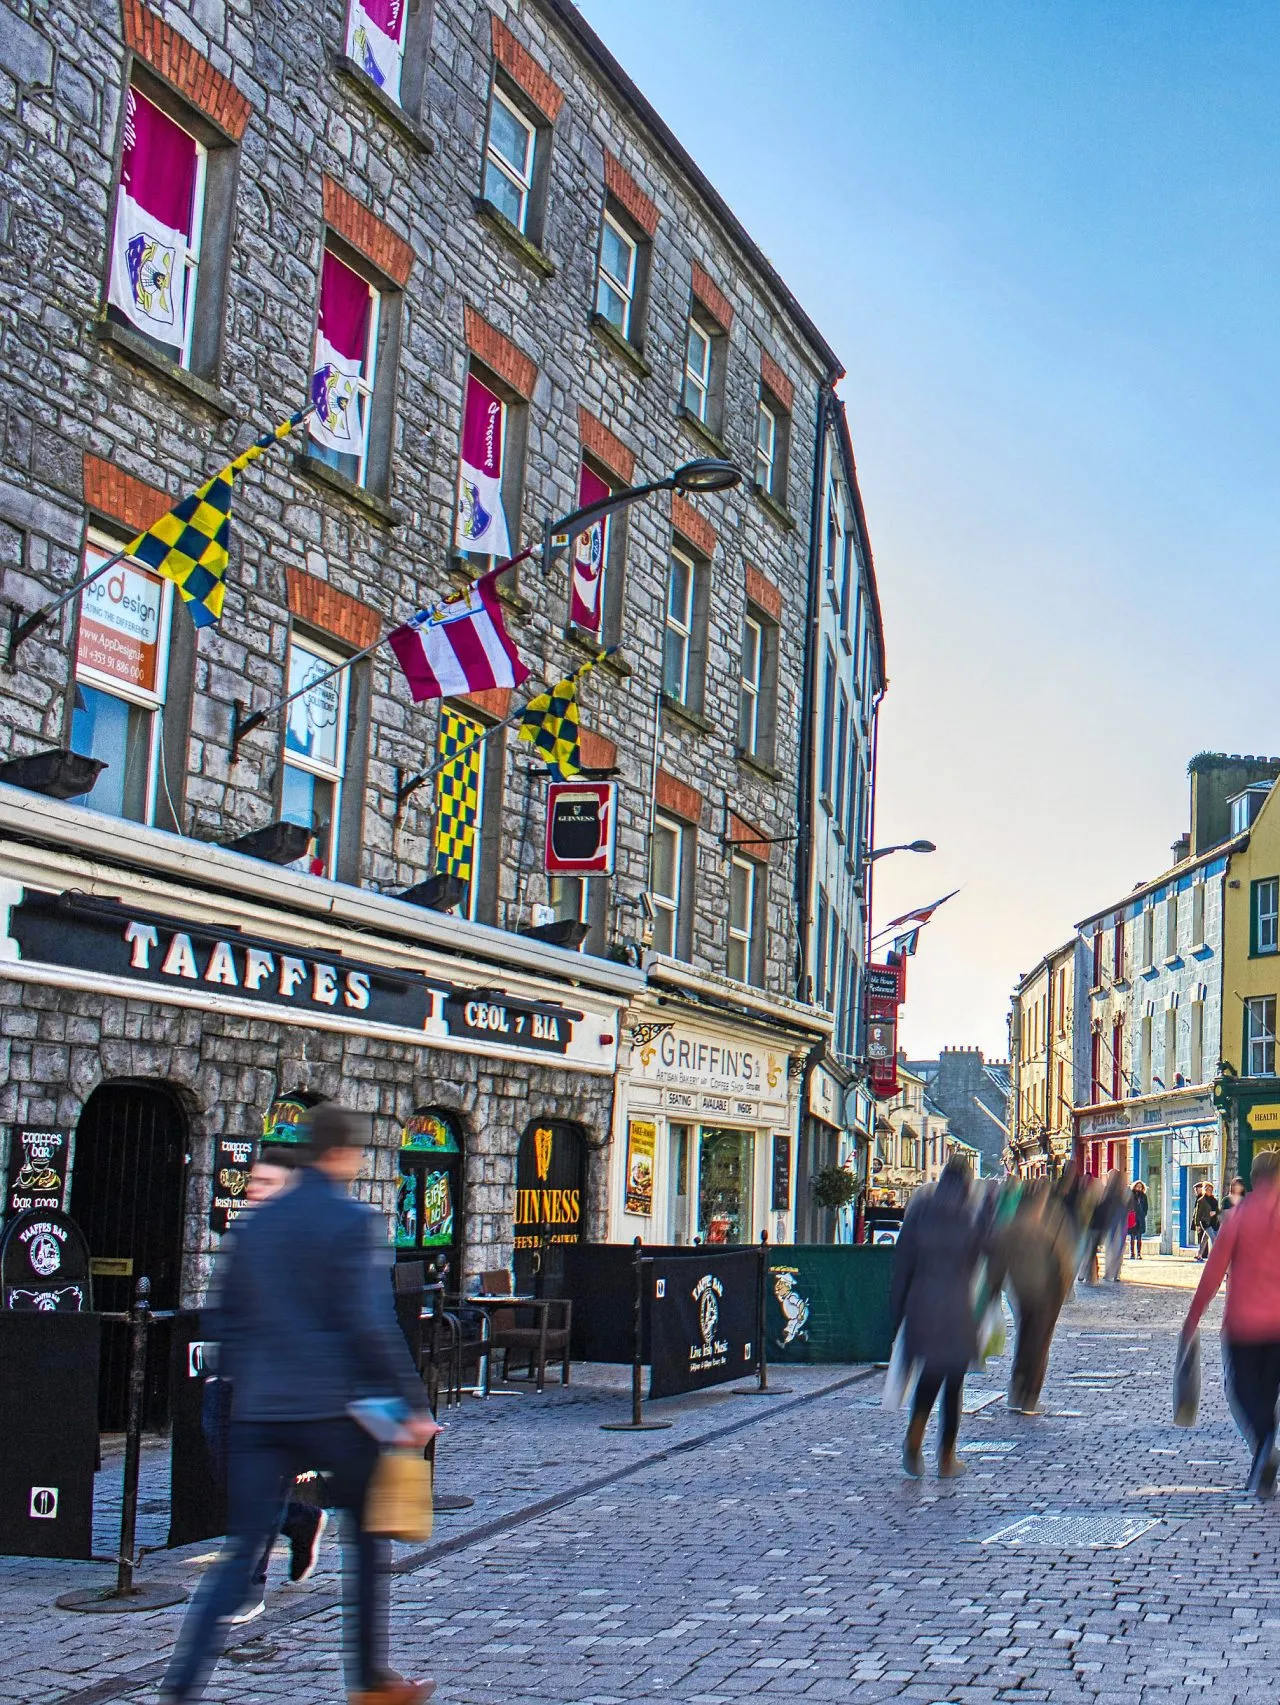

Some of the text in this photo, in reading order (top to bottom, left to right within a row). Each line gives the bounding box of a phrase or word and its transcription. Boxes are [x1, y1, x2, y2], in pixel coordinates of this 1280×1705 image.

[124, 921, 371, 1010] TAAFFES
[464, 1001, 509, 1032] CEOL
[531, 1014, 560, 1041] BIA
[660, 1030, 753, 1080] GRIFFIN'S
[679, 1072, 700, 1086] BAKERY
[710, 1077, 729, 1091] COFFEE
[668, 1092, 752, 1115] SEATING AVAILABLE INSIDE
[1254, 1112, 1278, 1122] HEALTH
[513, 1189, 580, 1225] UINNESS
[52, 1224, 68, 1242] BAR
